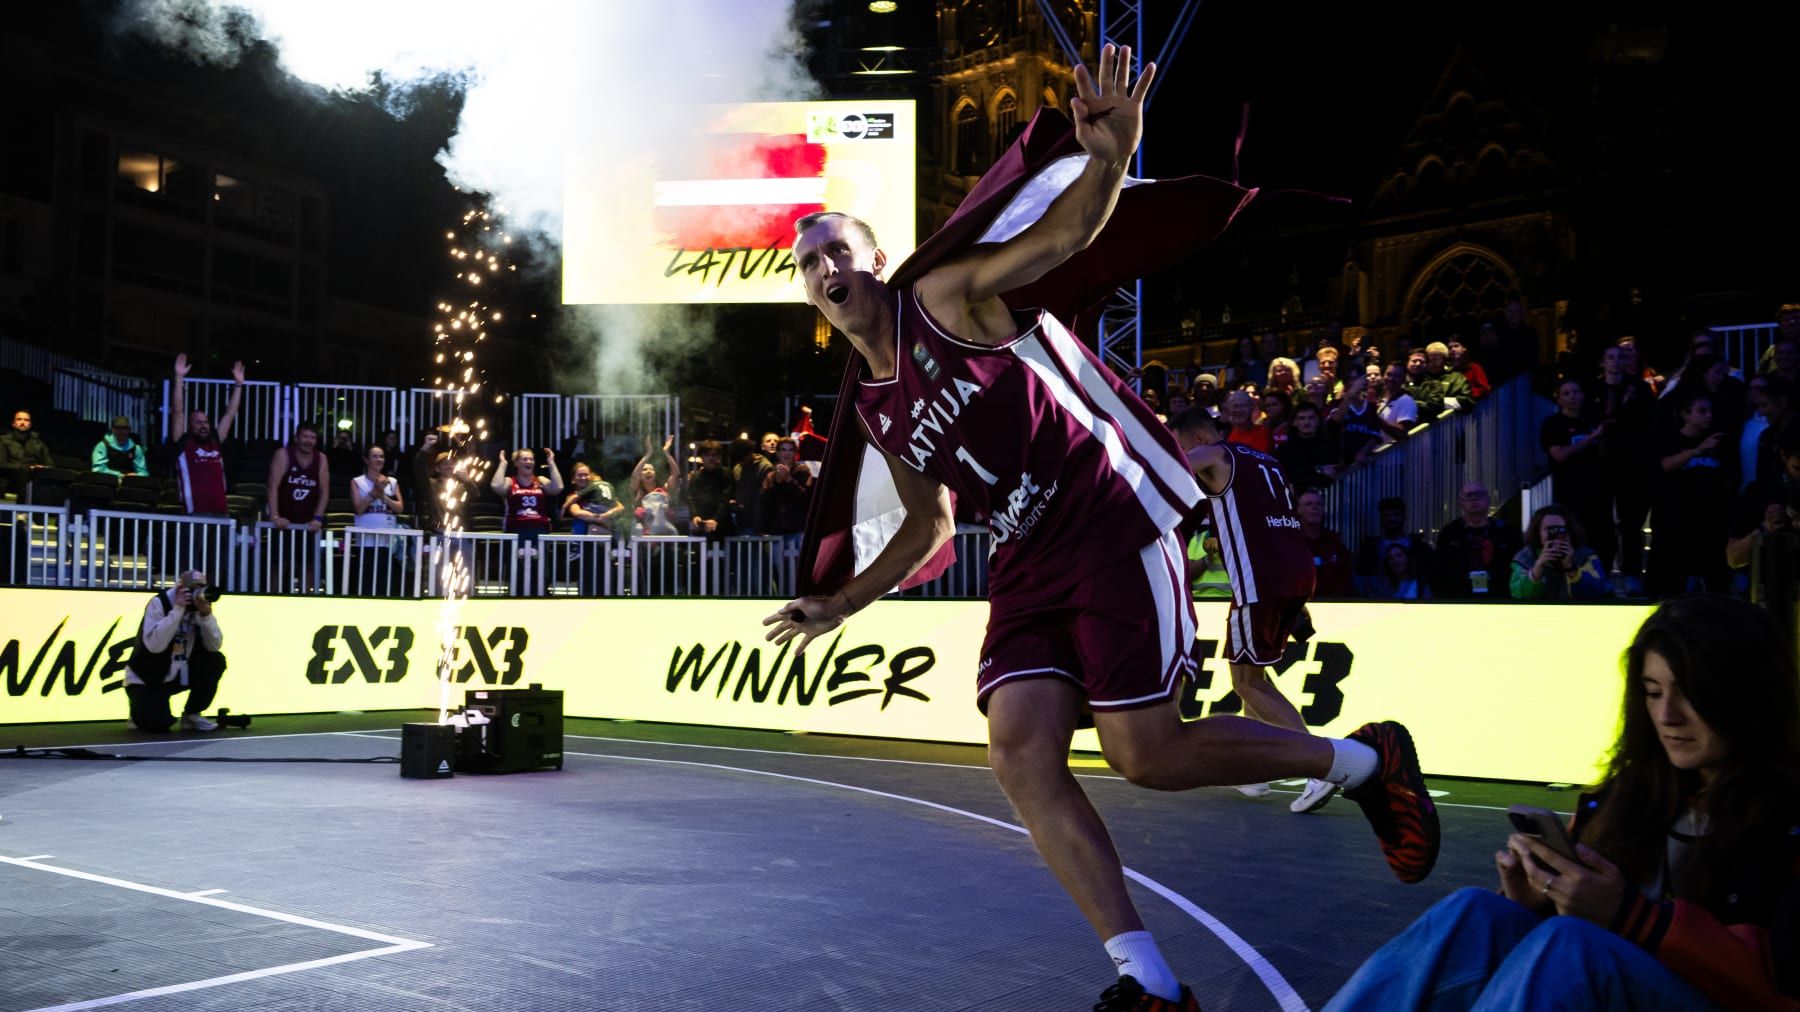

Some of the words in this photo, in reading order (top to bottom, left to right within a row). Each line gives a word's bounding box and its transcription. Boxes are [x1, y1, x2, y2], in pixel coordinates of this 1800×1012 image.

[900, 377, 982, 473] LATVIJA
[955, 446, 999, 486] 1
[521, 496, 537, 507] 33
[665, 626, 936, 712] WINNER
